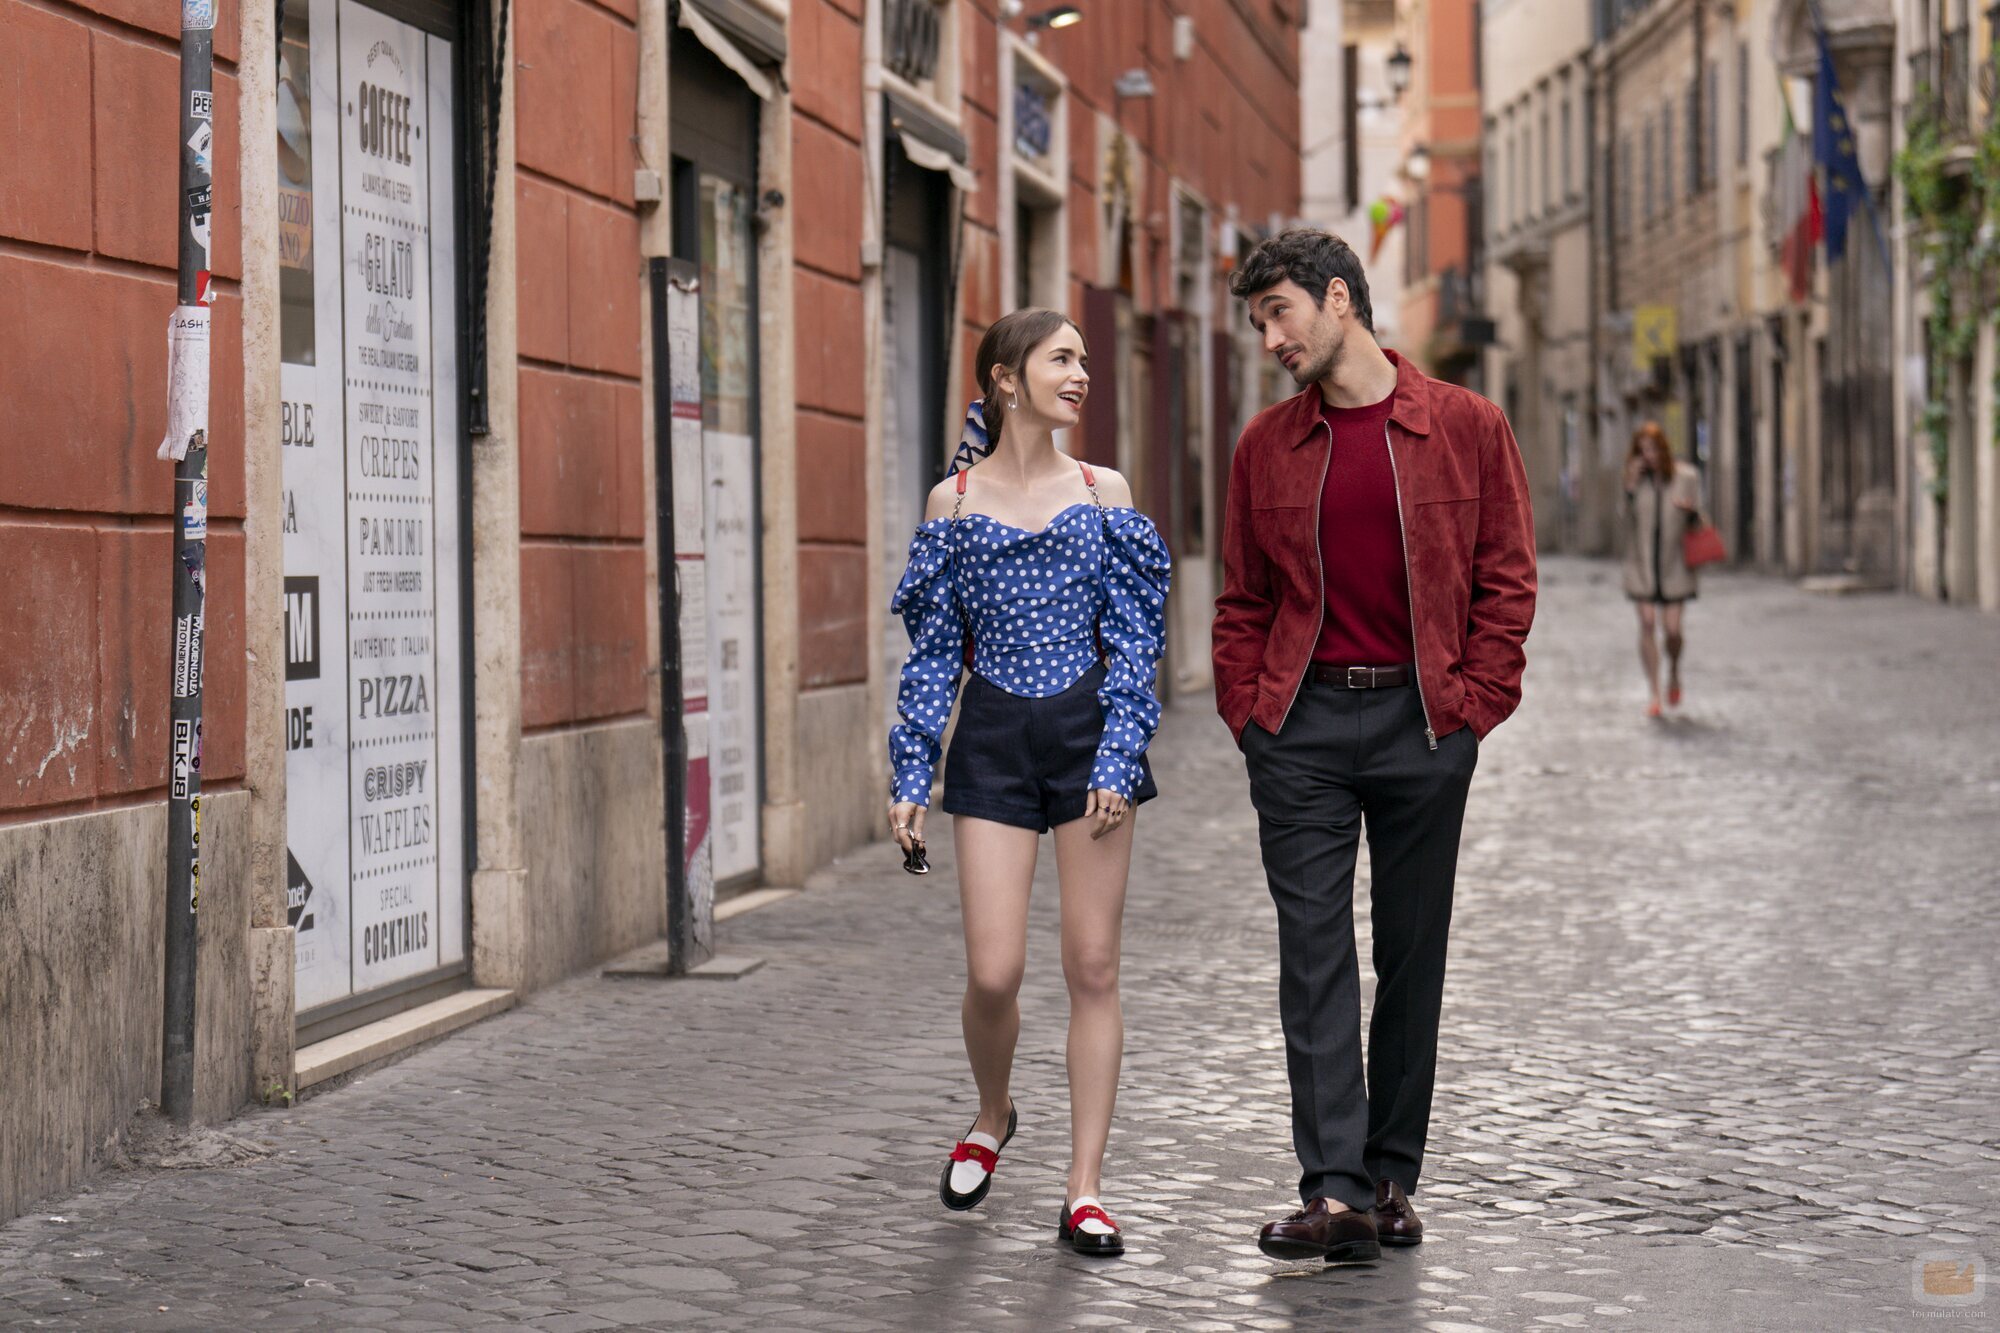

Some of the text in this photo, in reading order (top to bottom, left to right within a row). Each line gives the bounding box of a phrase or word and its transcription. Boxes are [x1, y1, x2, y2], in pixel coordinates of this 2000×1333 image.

[359, 80, 411, 167] COFFEE
[397, 182, 412, 205] FRESH
[365, 232, 414, 300] GELATO
[358, 345, 419, 373] THE REAL ITALIAN ICE CREAM
[359, 402, 419, 429] SWEET & SAVORY
[360, 425, 419, 480] CRÈPES
[360, 517, 423, 555] PANINI
[362, 571, 375, 593] JUST
[376, 571, 393, 593] FRESH
[353, 635, 430, 659] AUTHENTIC ITALIAN
[359, 673, 430, 719] PIZZA
[364, 759, 428, 802] CRISPY
[360, 803, 430, 856] WAFFLES
[380, 883, 413, 911] SPECIAL
[364, 910, 428, 966] COCKTAILS
